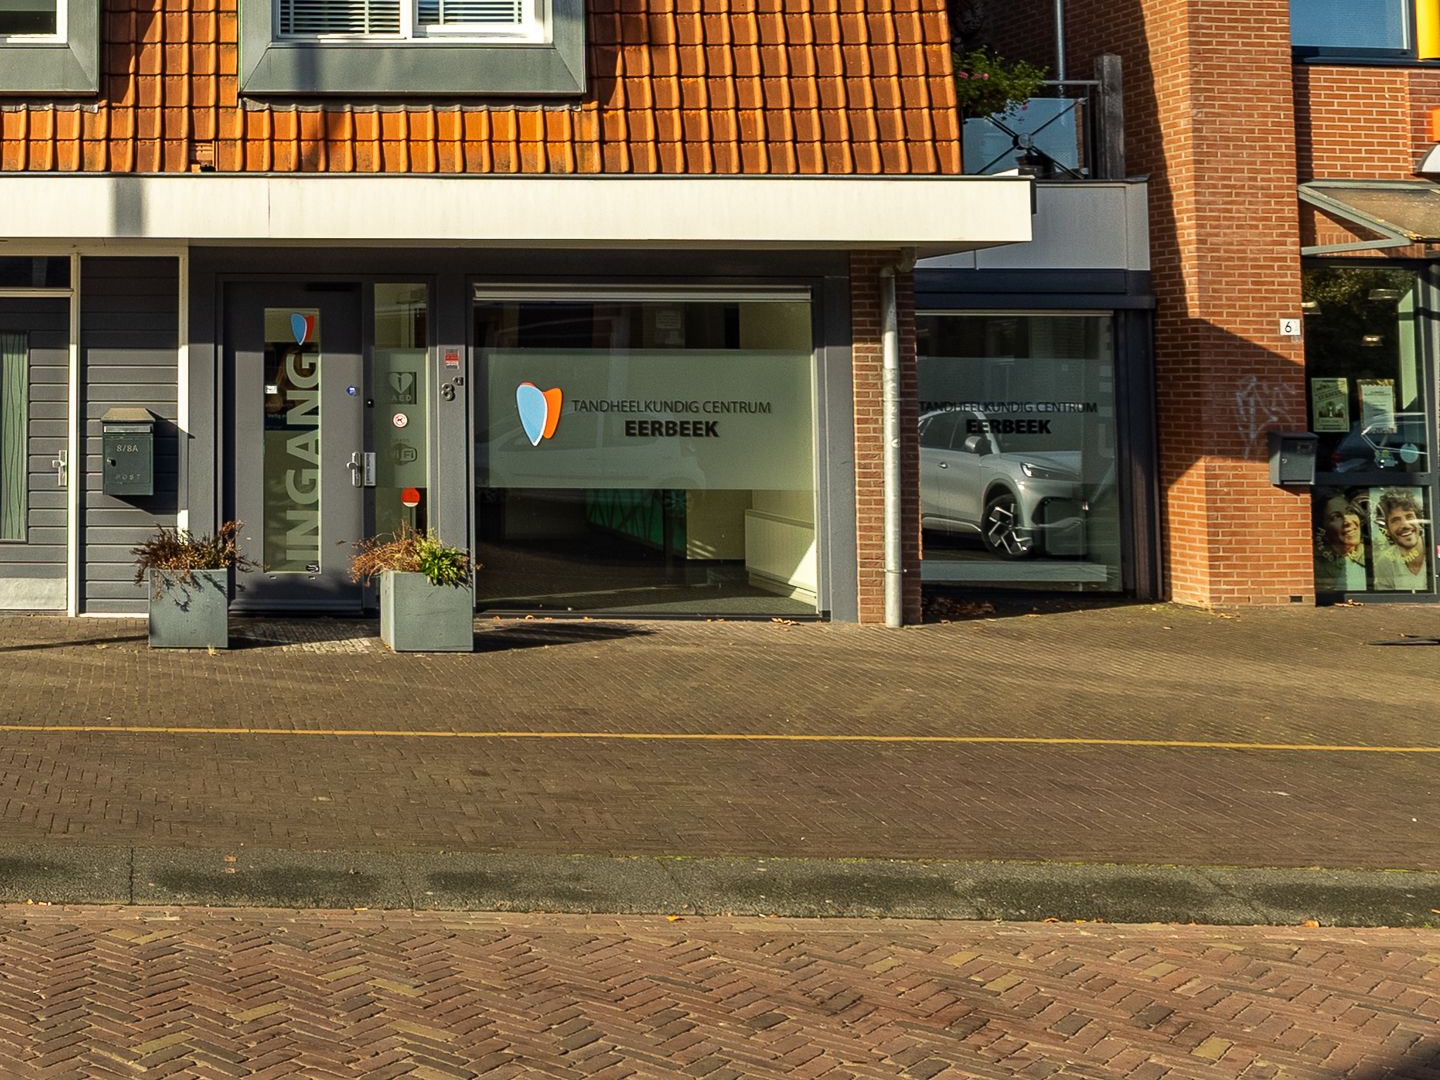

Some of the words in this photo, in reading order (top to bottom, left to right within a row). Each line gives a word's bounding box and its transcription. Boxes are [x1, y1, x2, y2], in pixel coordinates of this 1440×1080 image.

[1284, 321, 1292, 333] 6
[391, 394, 412, 402] AED
[571, 399, 699, 413] TANDHEELKUNDIG
[702, 400, 771, 414] CENTRUM
[920, 401, 1033, 413] TANDHEELKUNDIG
[1036, 402, 1098, 413] CENTRUM
[625, 420, 719, 437] EERBEEK
[966, 419, 1051, 434] EERBEEK
[116, 444, 138, 452] 8/8A
[286, 353, 319, 560] INGANG
